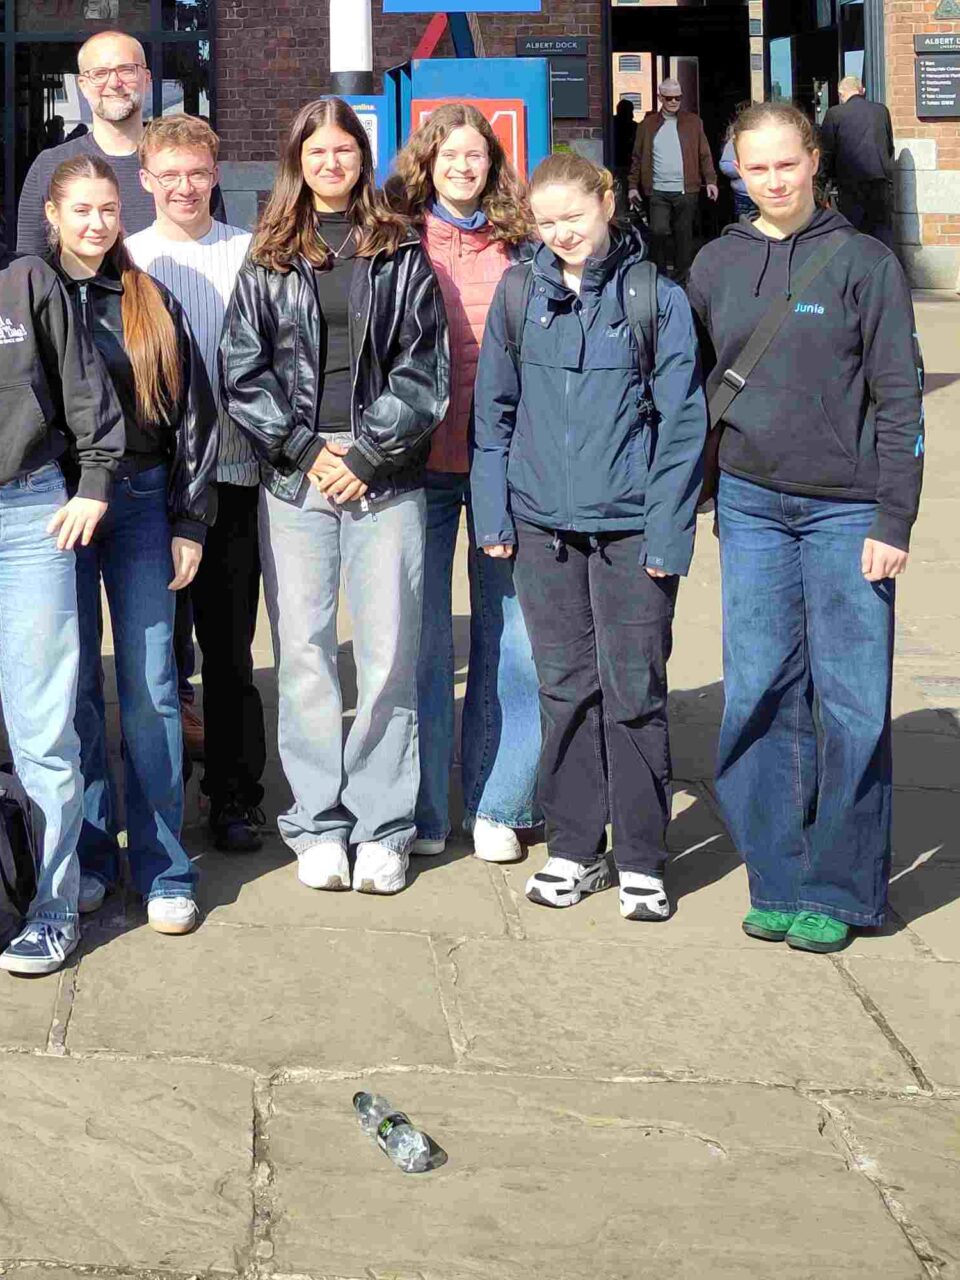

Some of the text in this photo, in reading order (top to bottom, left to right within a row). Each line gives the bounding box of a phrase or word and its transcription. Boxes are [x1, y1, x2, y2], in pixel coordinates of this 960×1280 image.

[555, 41, 578, 49] DOCK
[924, 37, 954, 45] ALBERT
[794, 303, 824, 314] Junia
